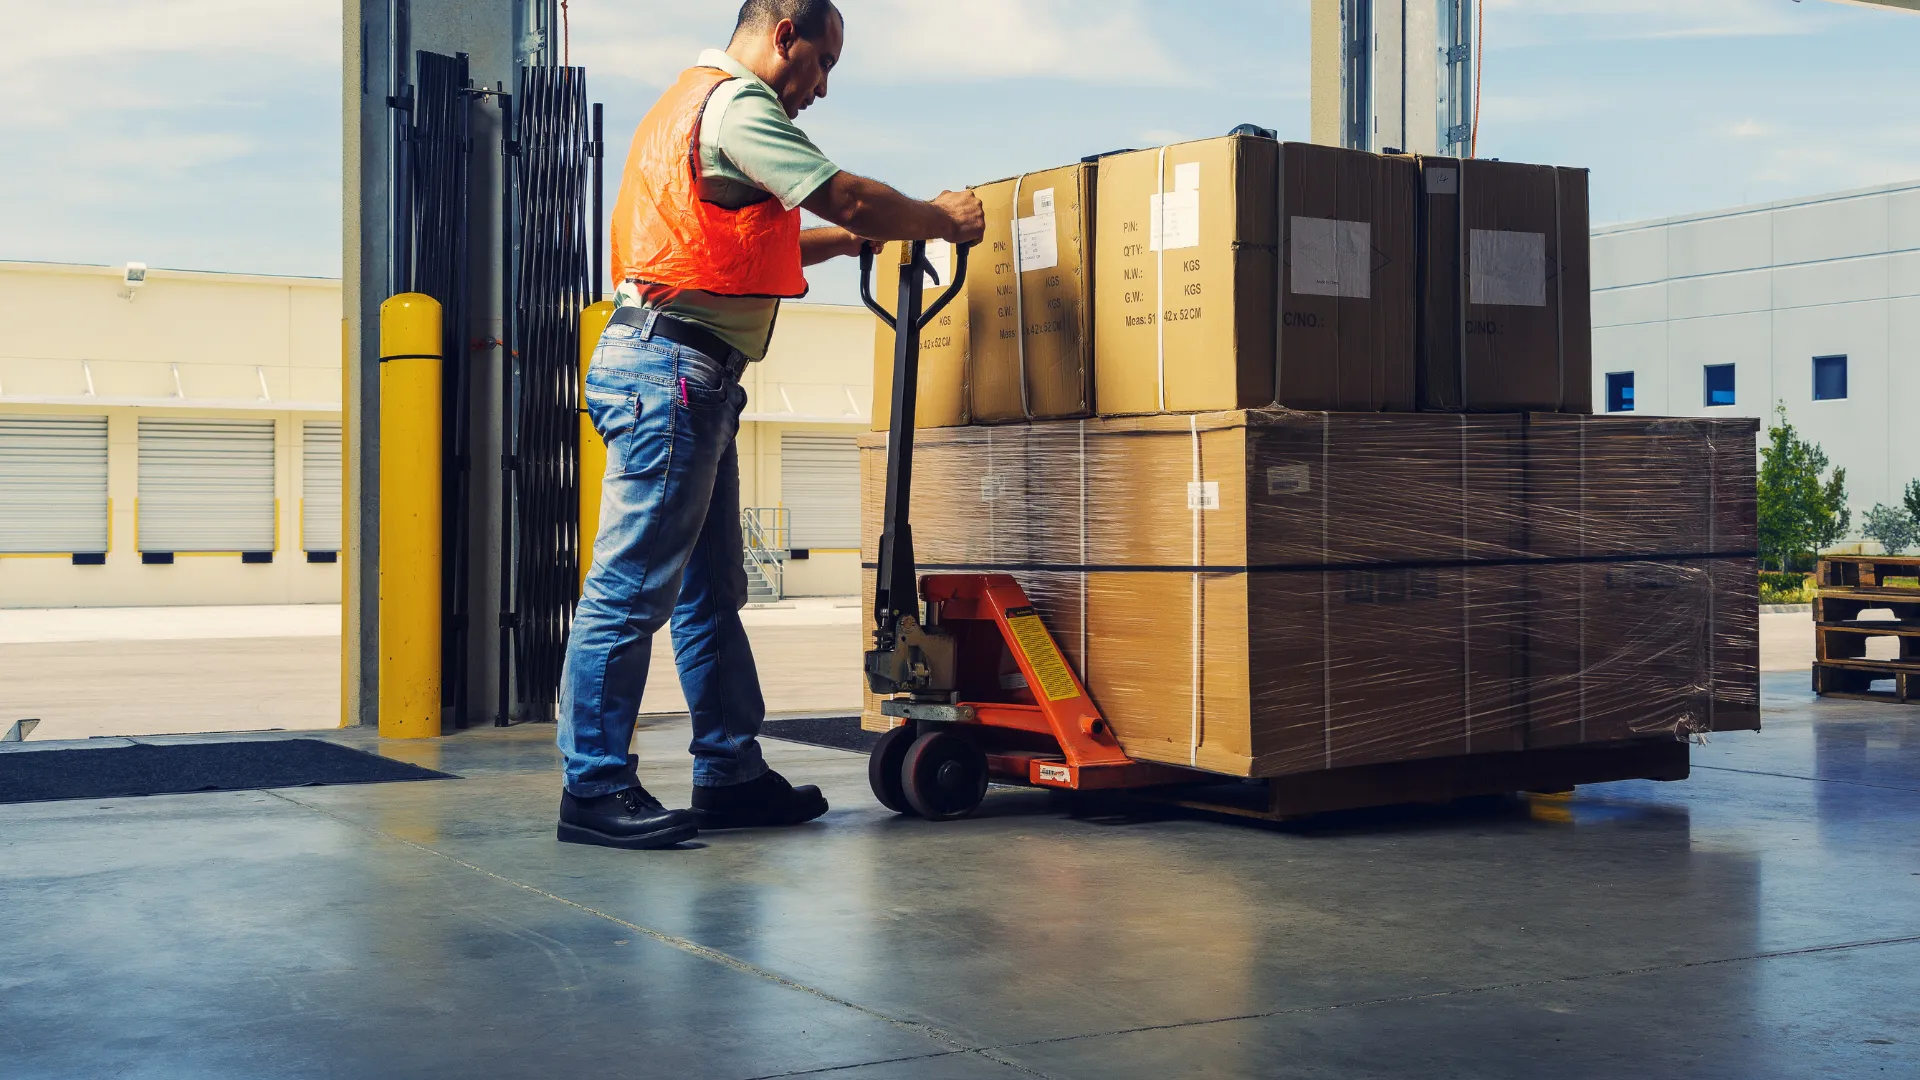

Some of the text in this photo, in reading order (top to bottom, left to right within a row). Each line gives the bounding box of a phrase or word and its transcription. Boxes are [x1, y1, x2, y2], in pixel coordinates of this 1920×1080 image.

[1124, 220, 1138, 234] P/N:
[994, 240, 1006, 252] P/N:
[1124, 244, 1143, 257] Q'TY:
[1124, 258, 1200, 280] N.W.: KGS
[1046, 276, 1060, 288] KGS
[1124, 282, 1202, 304] G.W.: KGS
[1048, 298, 1062, 309] KGS
[940, 315, 952, 327] KGS
[1125, 314, 1146, 327] Meas:
[1283, 311, 1325, 328] C/NO.:
[1465, 320, 1504, 335] C/NO.:
